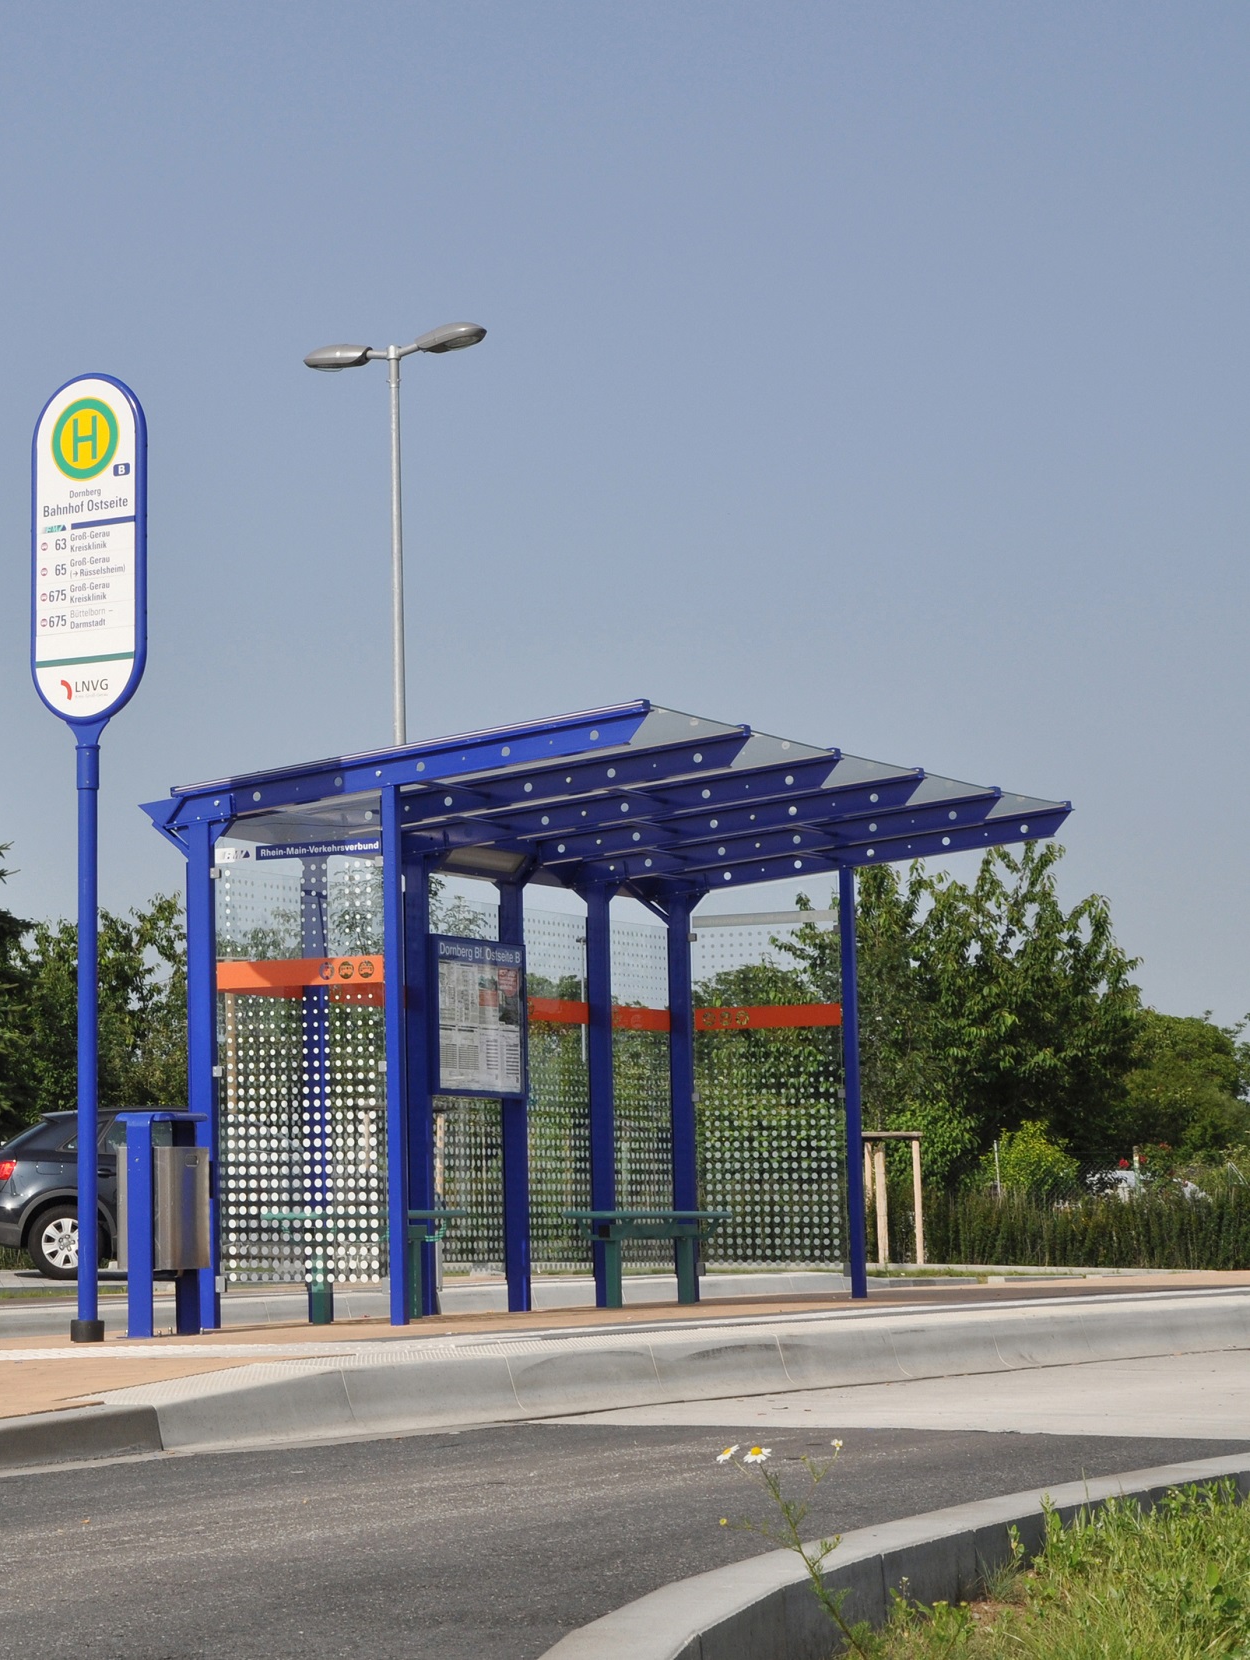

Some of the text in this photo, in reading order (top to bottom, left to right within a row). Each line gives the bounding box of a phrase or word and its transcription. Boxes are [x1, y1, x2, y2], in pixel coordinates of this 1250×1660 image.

[72, 414, 98, 463] H
[117, 464, 126, 475] B
[69, 487, 102, 499] Dornberg
[43, 495, 129, 518] Bahnhof Ostseite
[54, 530, 111, 551] 63 Groß-Gerau
[70, 541, 107, 553] Kreisklinik
[54, 555, 111, 577] 65 Groß-Gerau
[48, 581, 111, 603] 675 Groß-Gerau
[70, 593, 107, 604] Kreisklinik
[48, 615, 67, 628] 675
[70, 618, 106, 630] Darmstadt
[75, 678, 109, 693] LNVG
[260, 840, 380, 857] Rhein-Main-Verkehrsverbund
[439, 942, 474, 961] Dornberg
[485, 947, 514, 963] Ostseite
[515, 951, 521, 964] B
